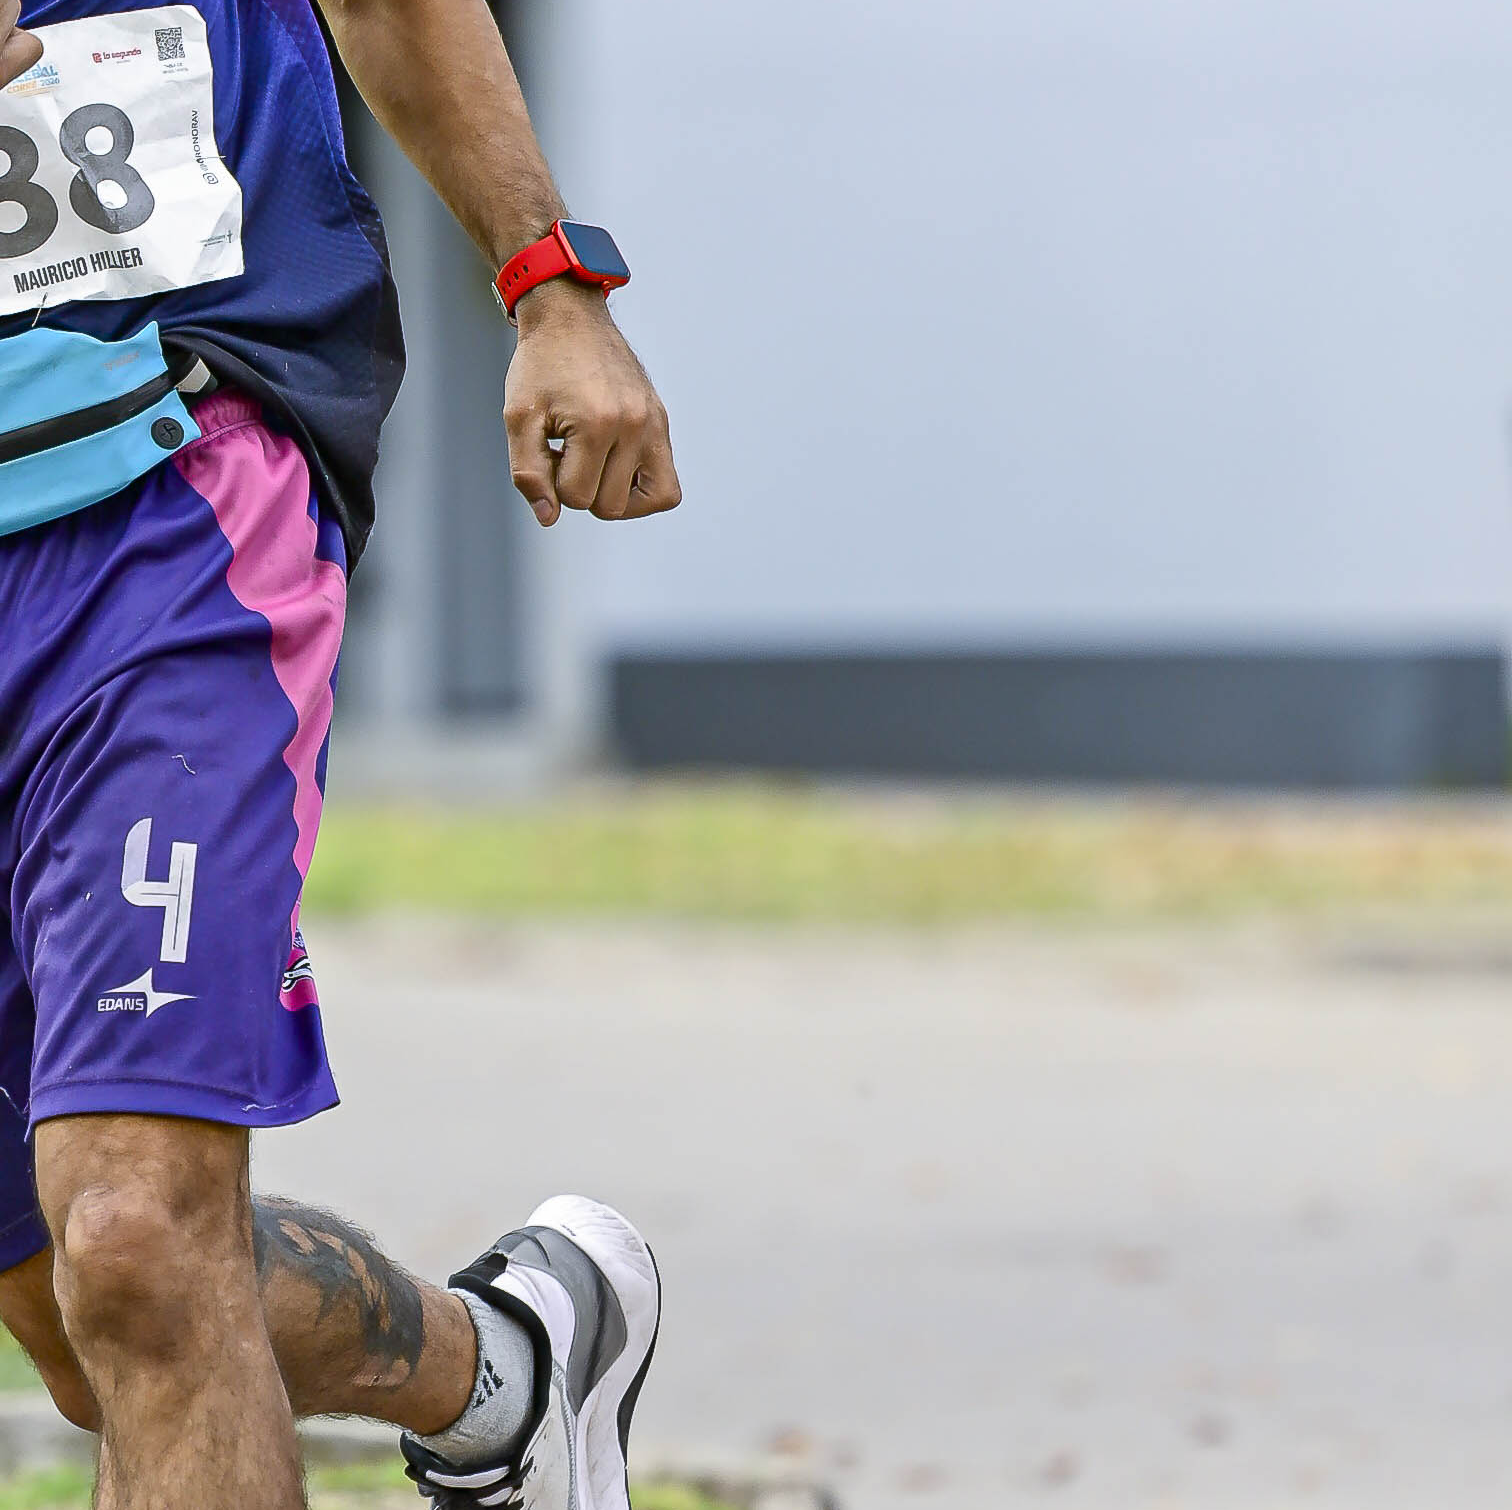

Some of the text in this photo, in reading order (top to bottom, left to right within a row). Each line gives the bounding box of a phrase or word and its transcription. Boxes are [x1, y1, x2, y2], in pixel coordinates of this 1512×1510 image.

[13, 256, 89, 294] MAURICIO
[121, 817, 198, 964] 4
[97, 997, 145, 1012] EDANS
